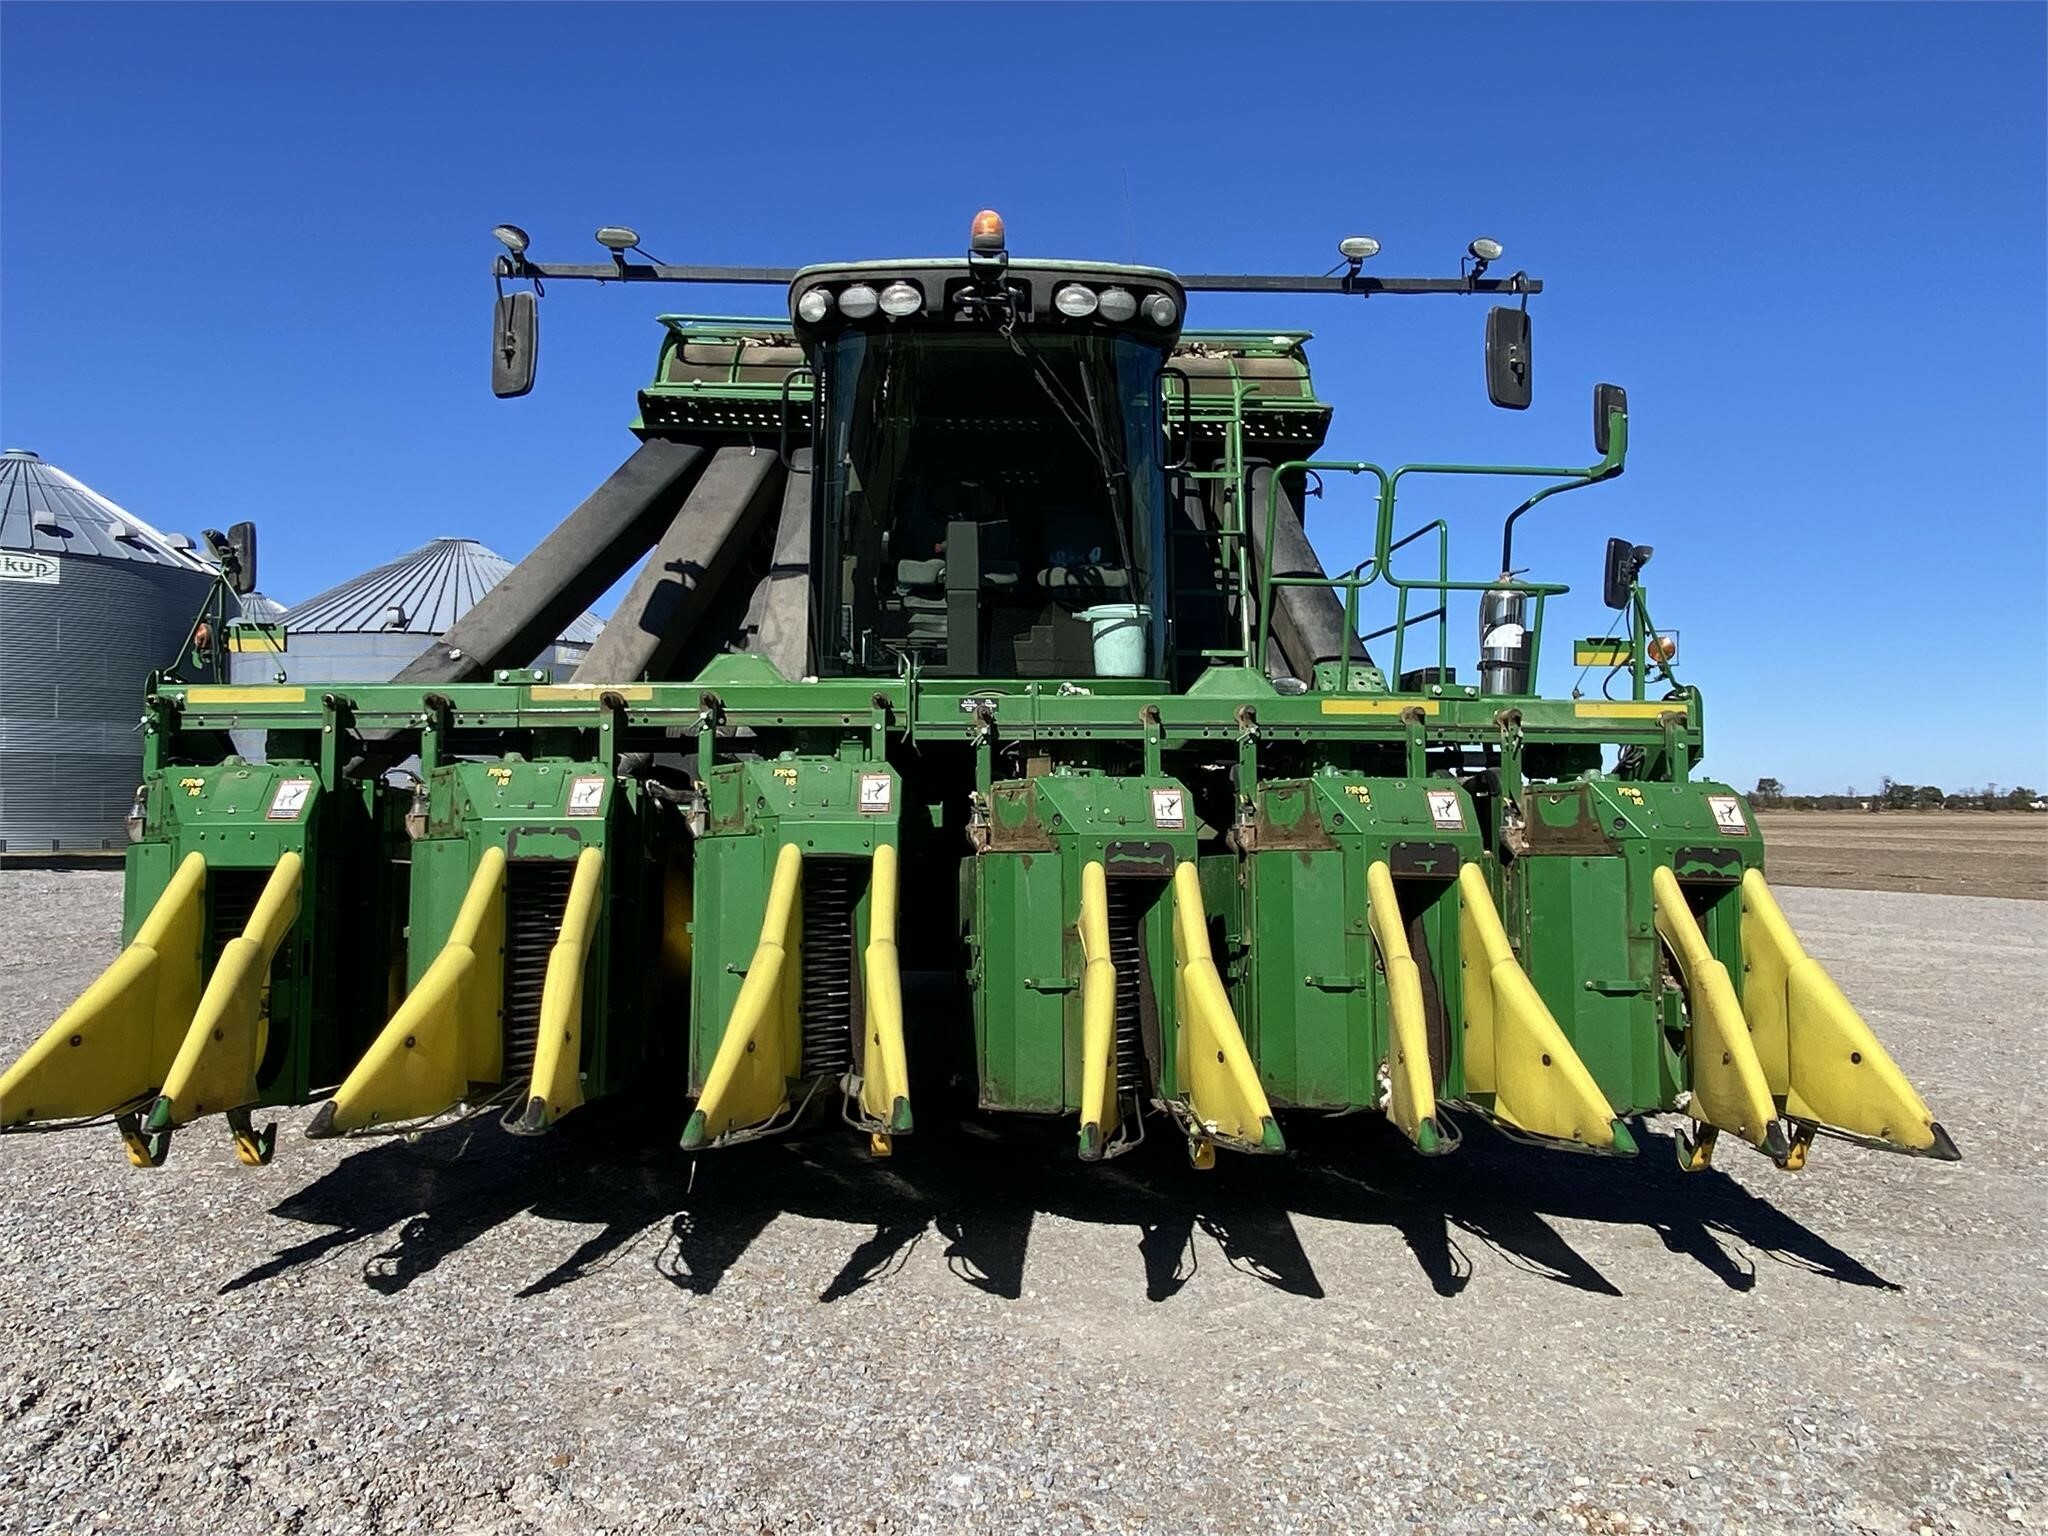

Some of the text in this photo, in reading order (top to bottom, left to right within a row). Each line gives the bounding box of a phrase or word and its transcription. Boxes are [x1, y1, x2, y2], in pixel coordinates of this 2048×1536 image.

[0, 557, 47, 578] kup
[486, 768, 513, 777] PRO
[773, 768, 798, 777] PRO
[179, 778, 206, 787] PRO
[1344, 786, 1369, 795] PRO
[1617, 787, 1642, 797] PRO
